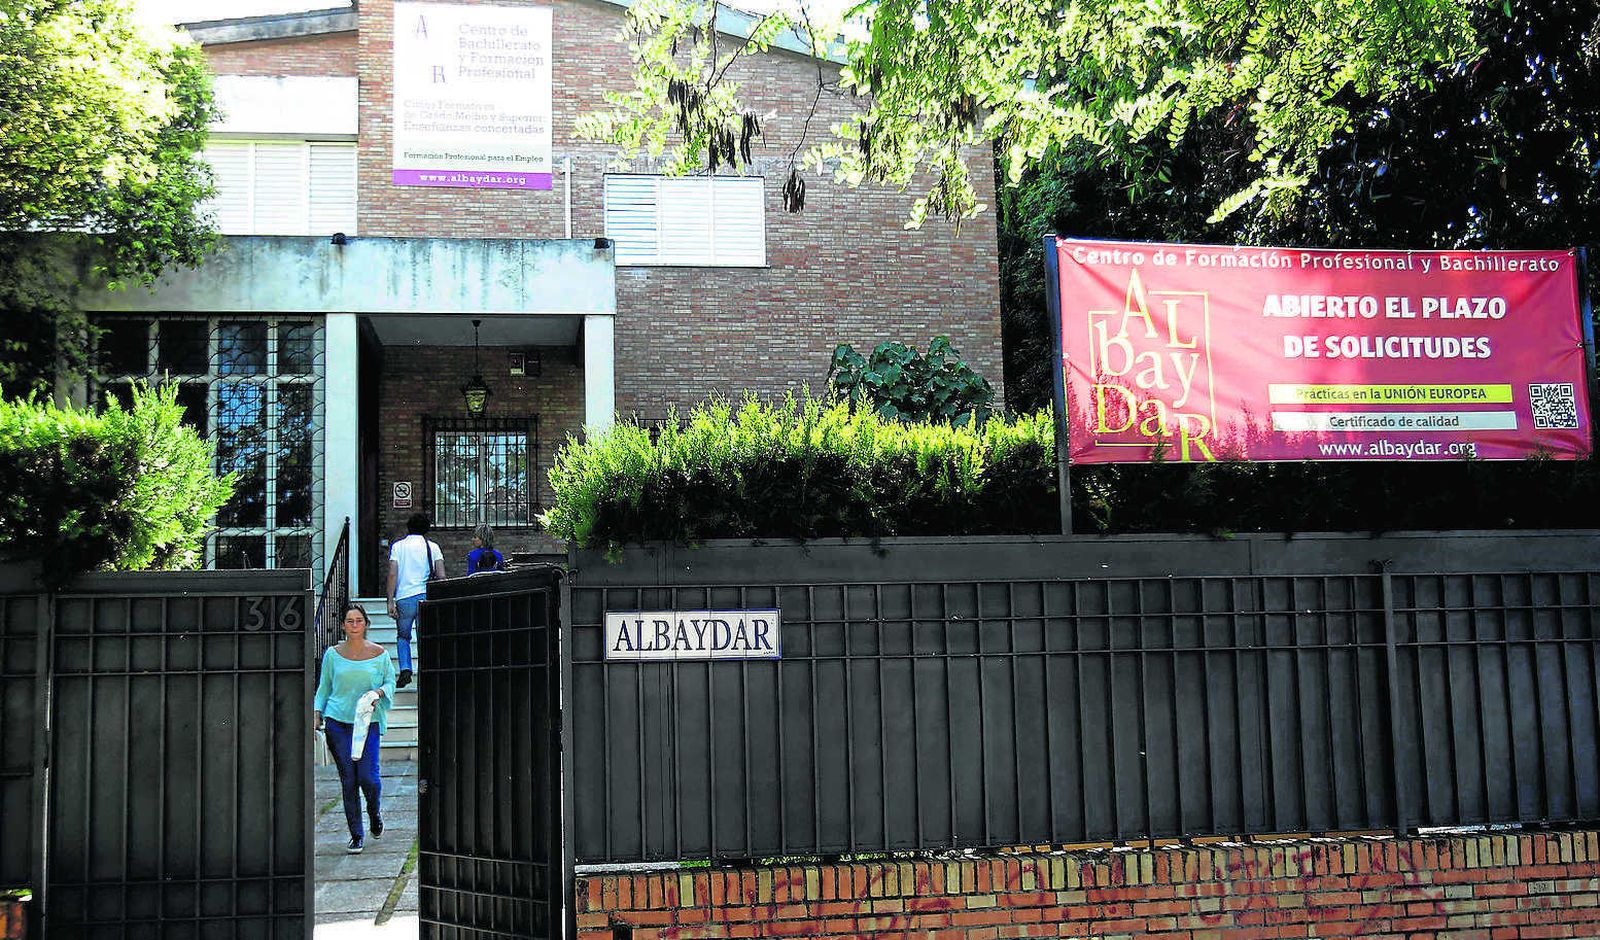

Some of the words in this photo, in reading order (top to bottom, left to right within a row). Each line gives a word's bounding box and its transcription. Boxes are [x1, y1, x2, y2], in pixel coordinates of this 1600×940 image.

[458, 24, 507, 37] Centro
[511, 25, 528, 36] de
[458, 37, 541, 51] Bachillerato
[458, 66, 536, 80] Profesional
[473, 123, 545, 135] concertadas
[506, 154, 514, 162] el
[514, 154, 544, 164] Empleo
[419, 173, 527, 186] www.albaydar.org
[1072, 247, 1145, 266] Centro
[1152, 249, 1178, 266] de
[1186, 247, 1293, 270] Formación
[1300, 252, 1414, 271] Profesional
[1421, 257, 1432, 274] y
[1440, 254, 1561, 273] Bachillerato
[1263, 294, 1378, 319] ABIERTO
[1385, 297, 1416, 319] EL
[1422, 297, 1507, 319] PLAZO
[1283, 335, 1319, 358] DE
[1325, 335, 1492, 359] SOLICITUDES
[1353, 389, 1367, 399] en
[1370, 387, 1381, 399] la
[1384, 386, 1426, 400] UNIÓN
[1429, 387, 1487, 399] EUROPEA
[1329, 415, 1394, 428] Certificado
[1398, 415, 1412, 427] de
[1416, 415, 1459, 427] calidad
[1318, 440, 1477, 459] www.albaydar.org
[244, 596, 301, 631] 36
[612, 619, 773, 652] ALBAYDAR
